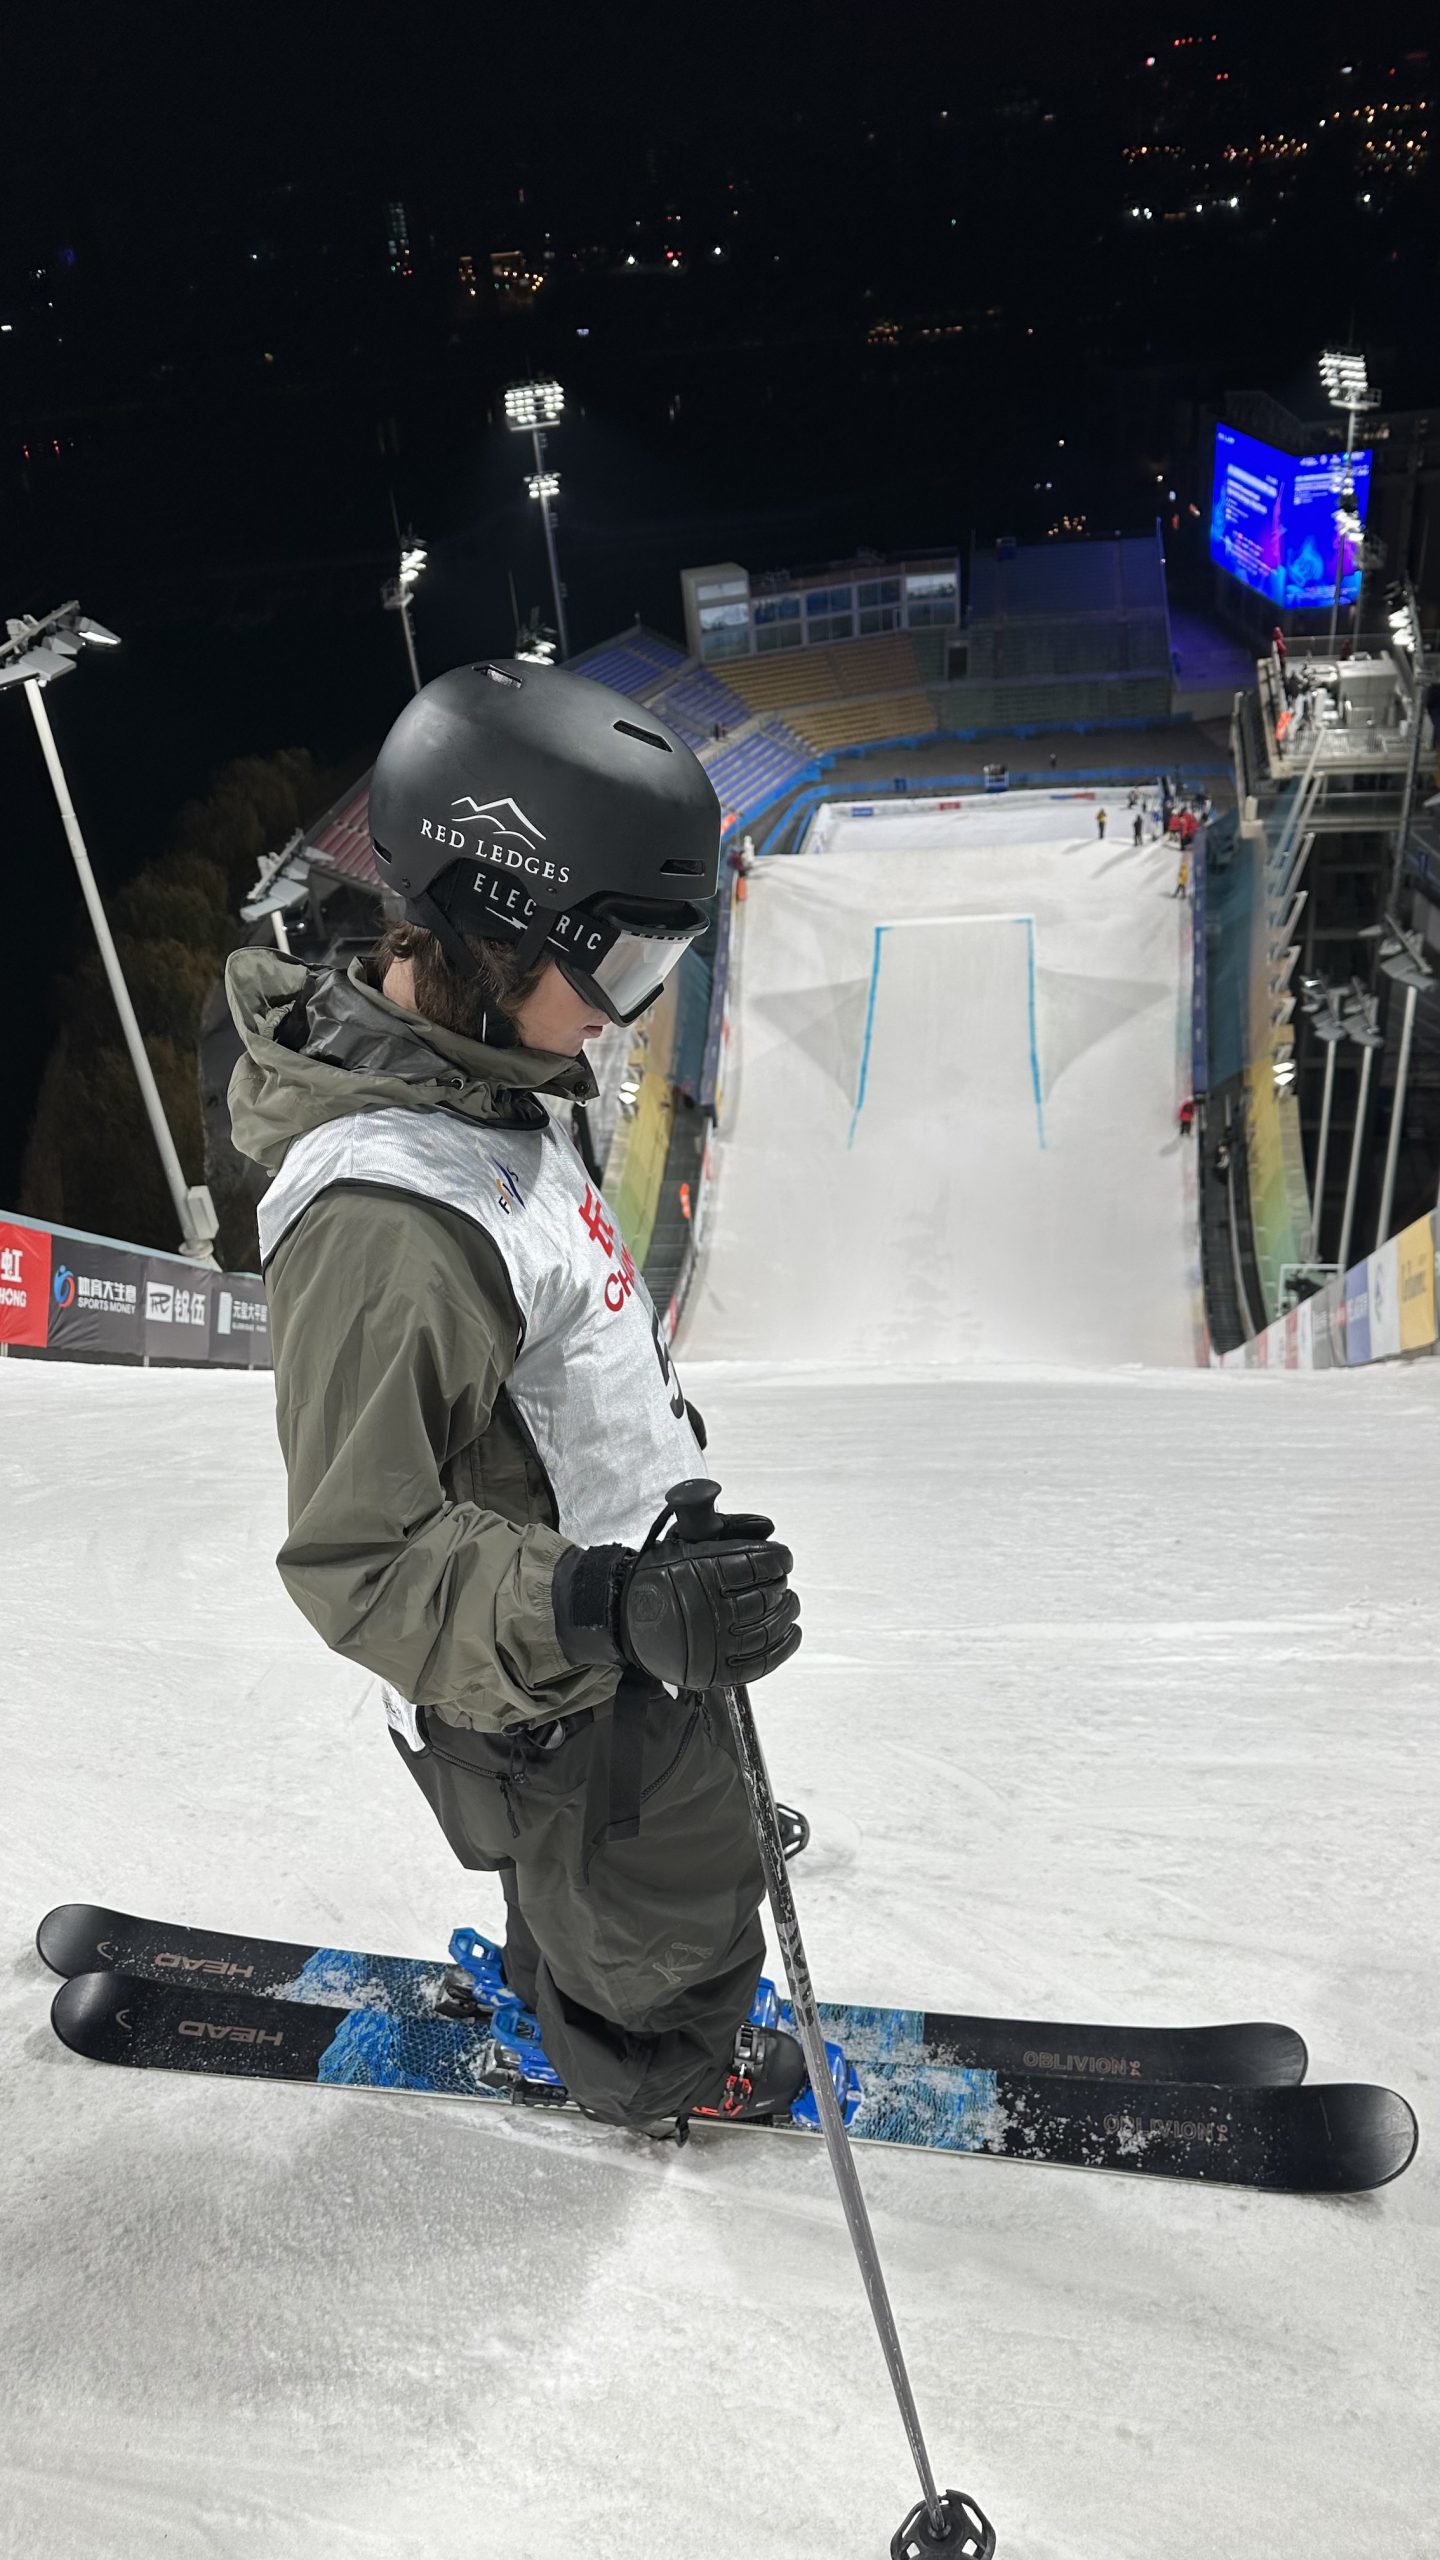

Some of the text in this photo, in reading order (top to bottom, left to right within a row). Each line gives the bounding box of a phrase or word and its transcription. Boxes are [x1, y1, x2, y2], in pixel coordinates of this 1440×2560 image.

[420, 818, 570, 884] RED LEDGES
[473, 872, 602, 951] ELECRIC
[1, 1247, 23, 1283] 虹
[77, 1297, 137, 1315] SPORTS MONEY
[154, 1952, 255, 1979] HEAD
[178, 2020, 284, 2047] HEAD
[1022, 2050, 1128, 2076] OBLIVION
